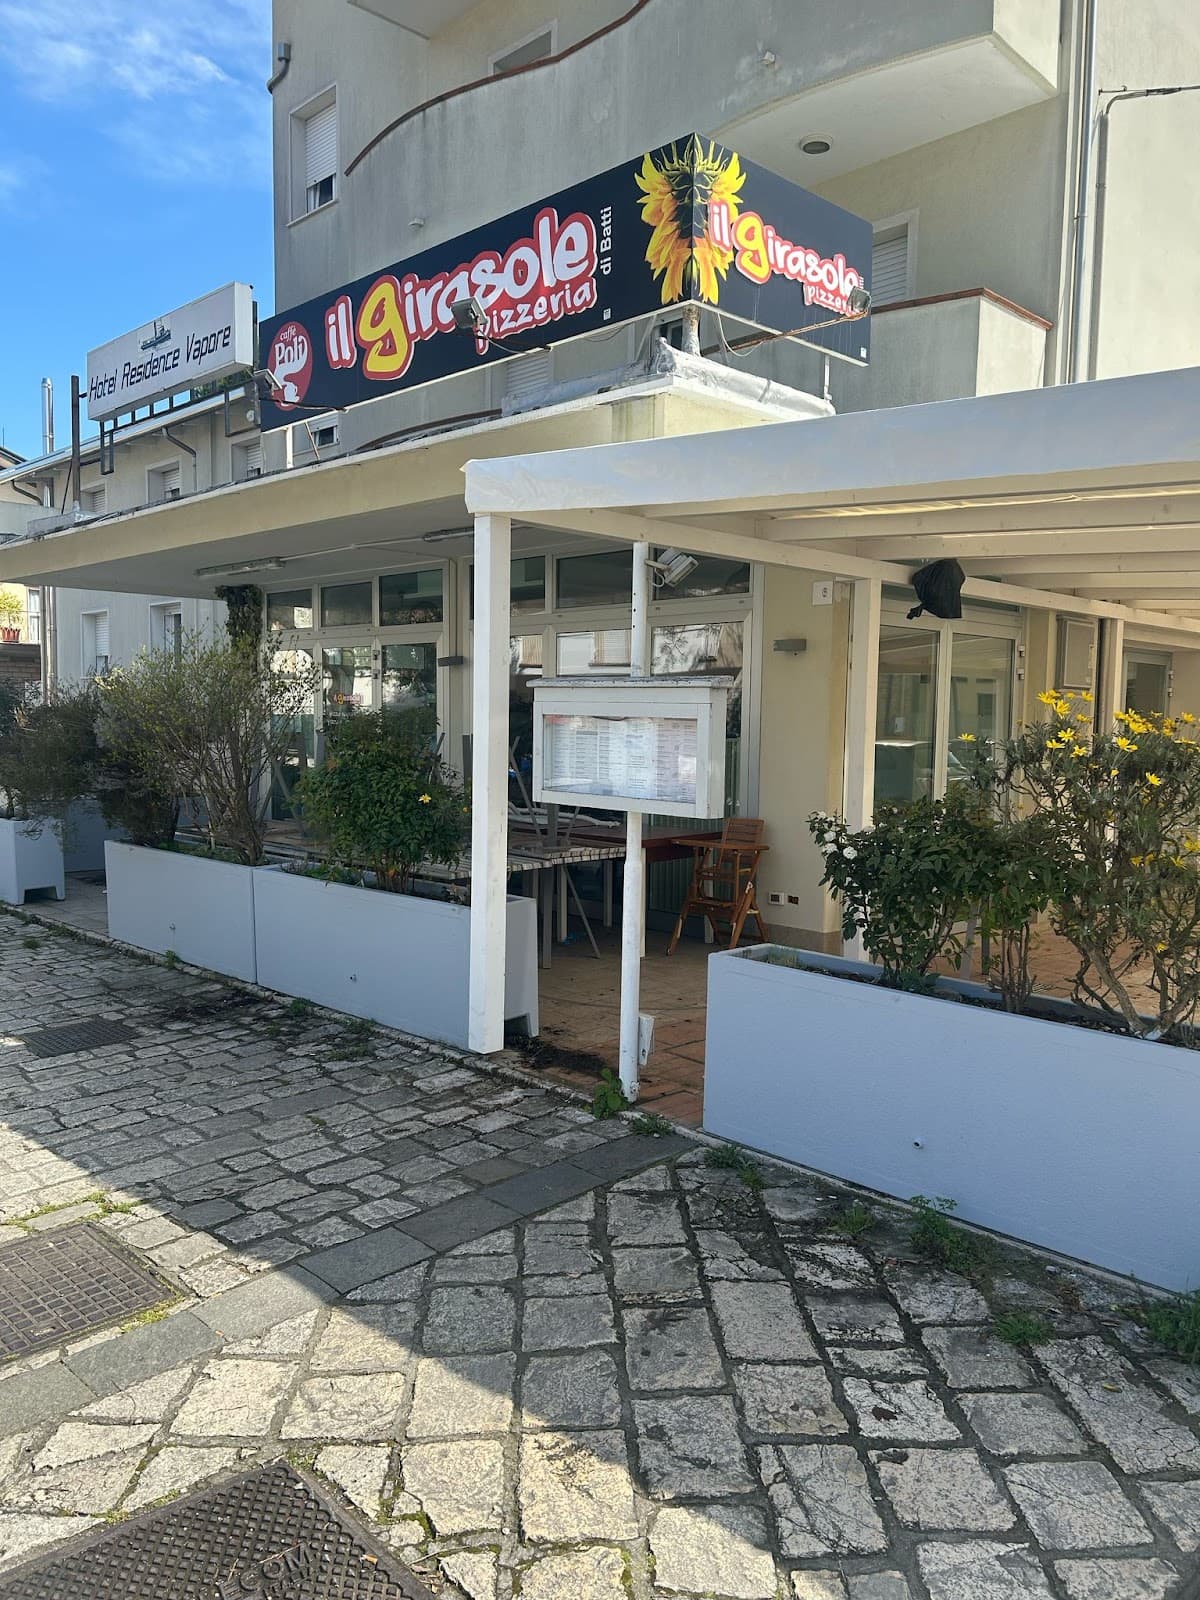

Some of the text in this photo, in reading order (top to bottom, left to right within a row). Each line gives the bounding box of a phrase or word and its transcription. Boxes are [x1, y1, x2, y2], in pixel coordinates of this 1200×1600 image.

[600, 206, 612, 275] di Batti
[710, 201, 732, 251] il
[326, 212, 592, 373] il girasole
[477, 280, 592, 350] pizzeria
[88, 325, 231, 402] Hotel Residence Vapore
